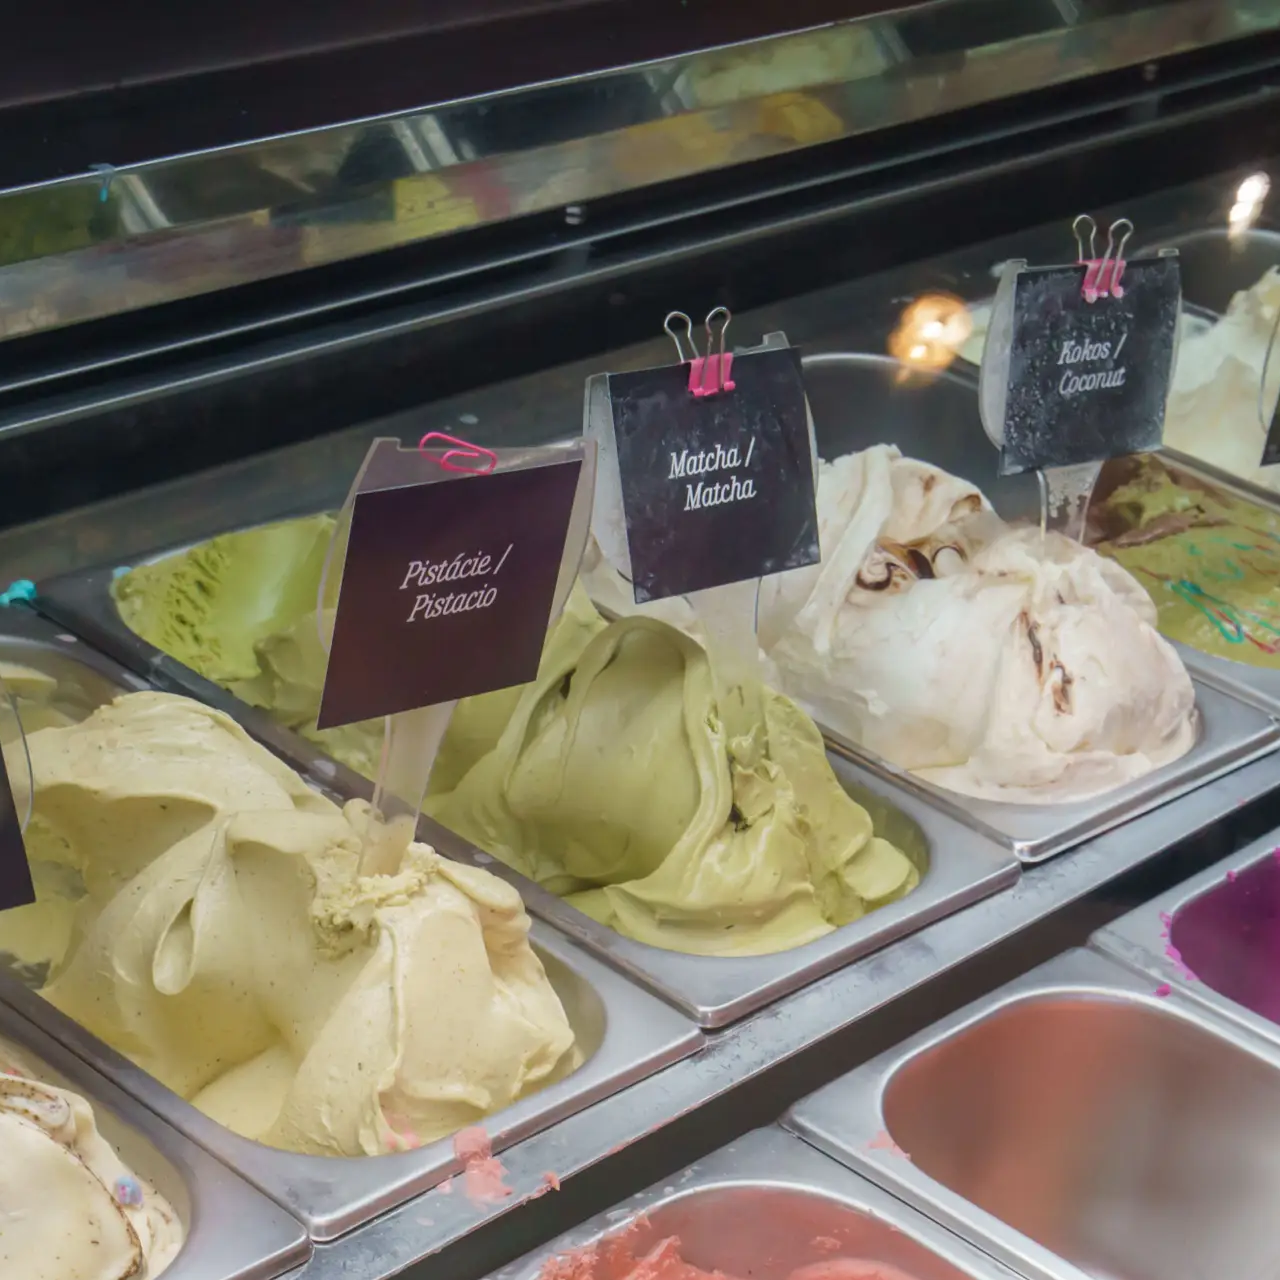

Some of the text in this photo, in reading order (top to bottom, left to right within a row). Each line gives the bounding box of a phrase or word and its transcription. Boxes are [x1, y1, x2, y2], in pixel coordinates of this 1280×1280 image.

[1057, 333, 1127, 365] Kokos /
[1059, 367, 1126, 394] Coconut
[668, 436, 756, 479] Matcha /
[684, 477, 756, 512] Matcha
[399, 544, 513, 590] Pistácie /
[407, 584, 498, 623] Pistacio
